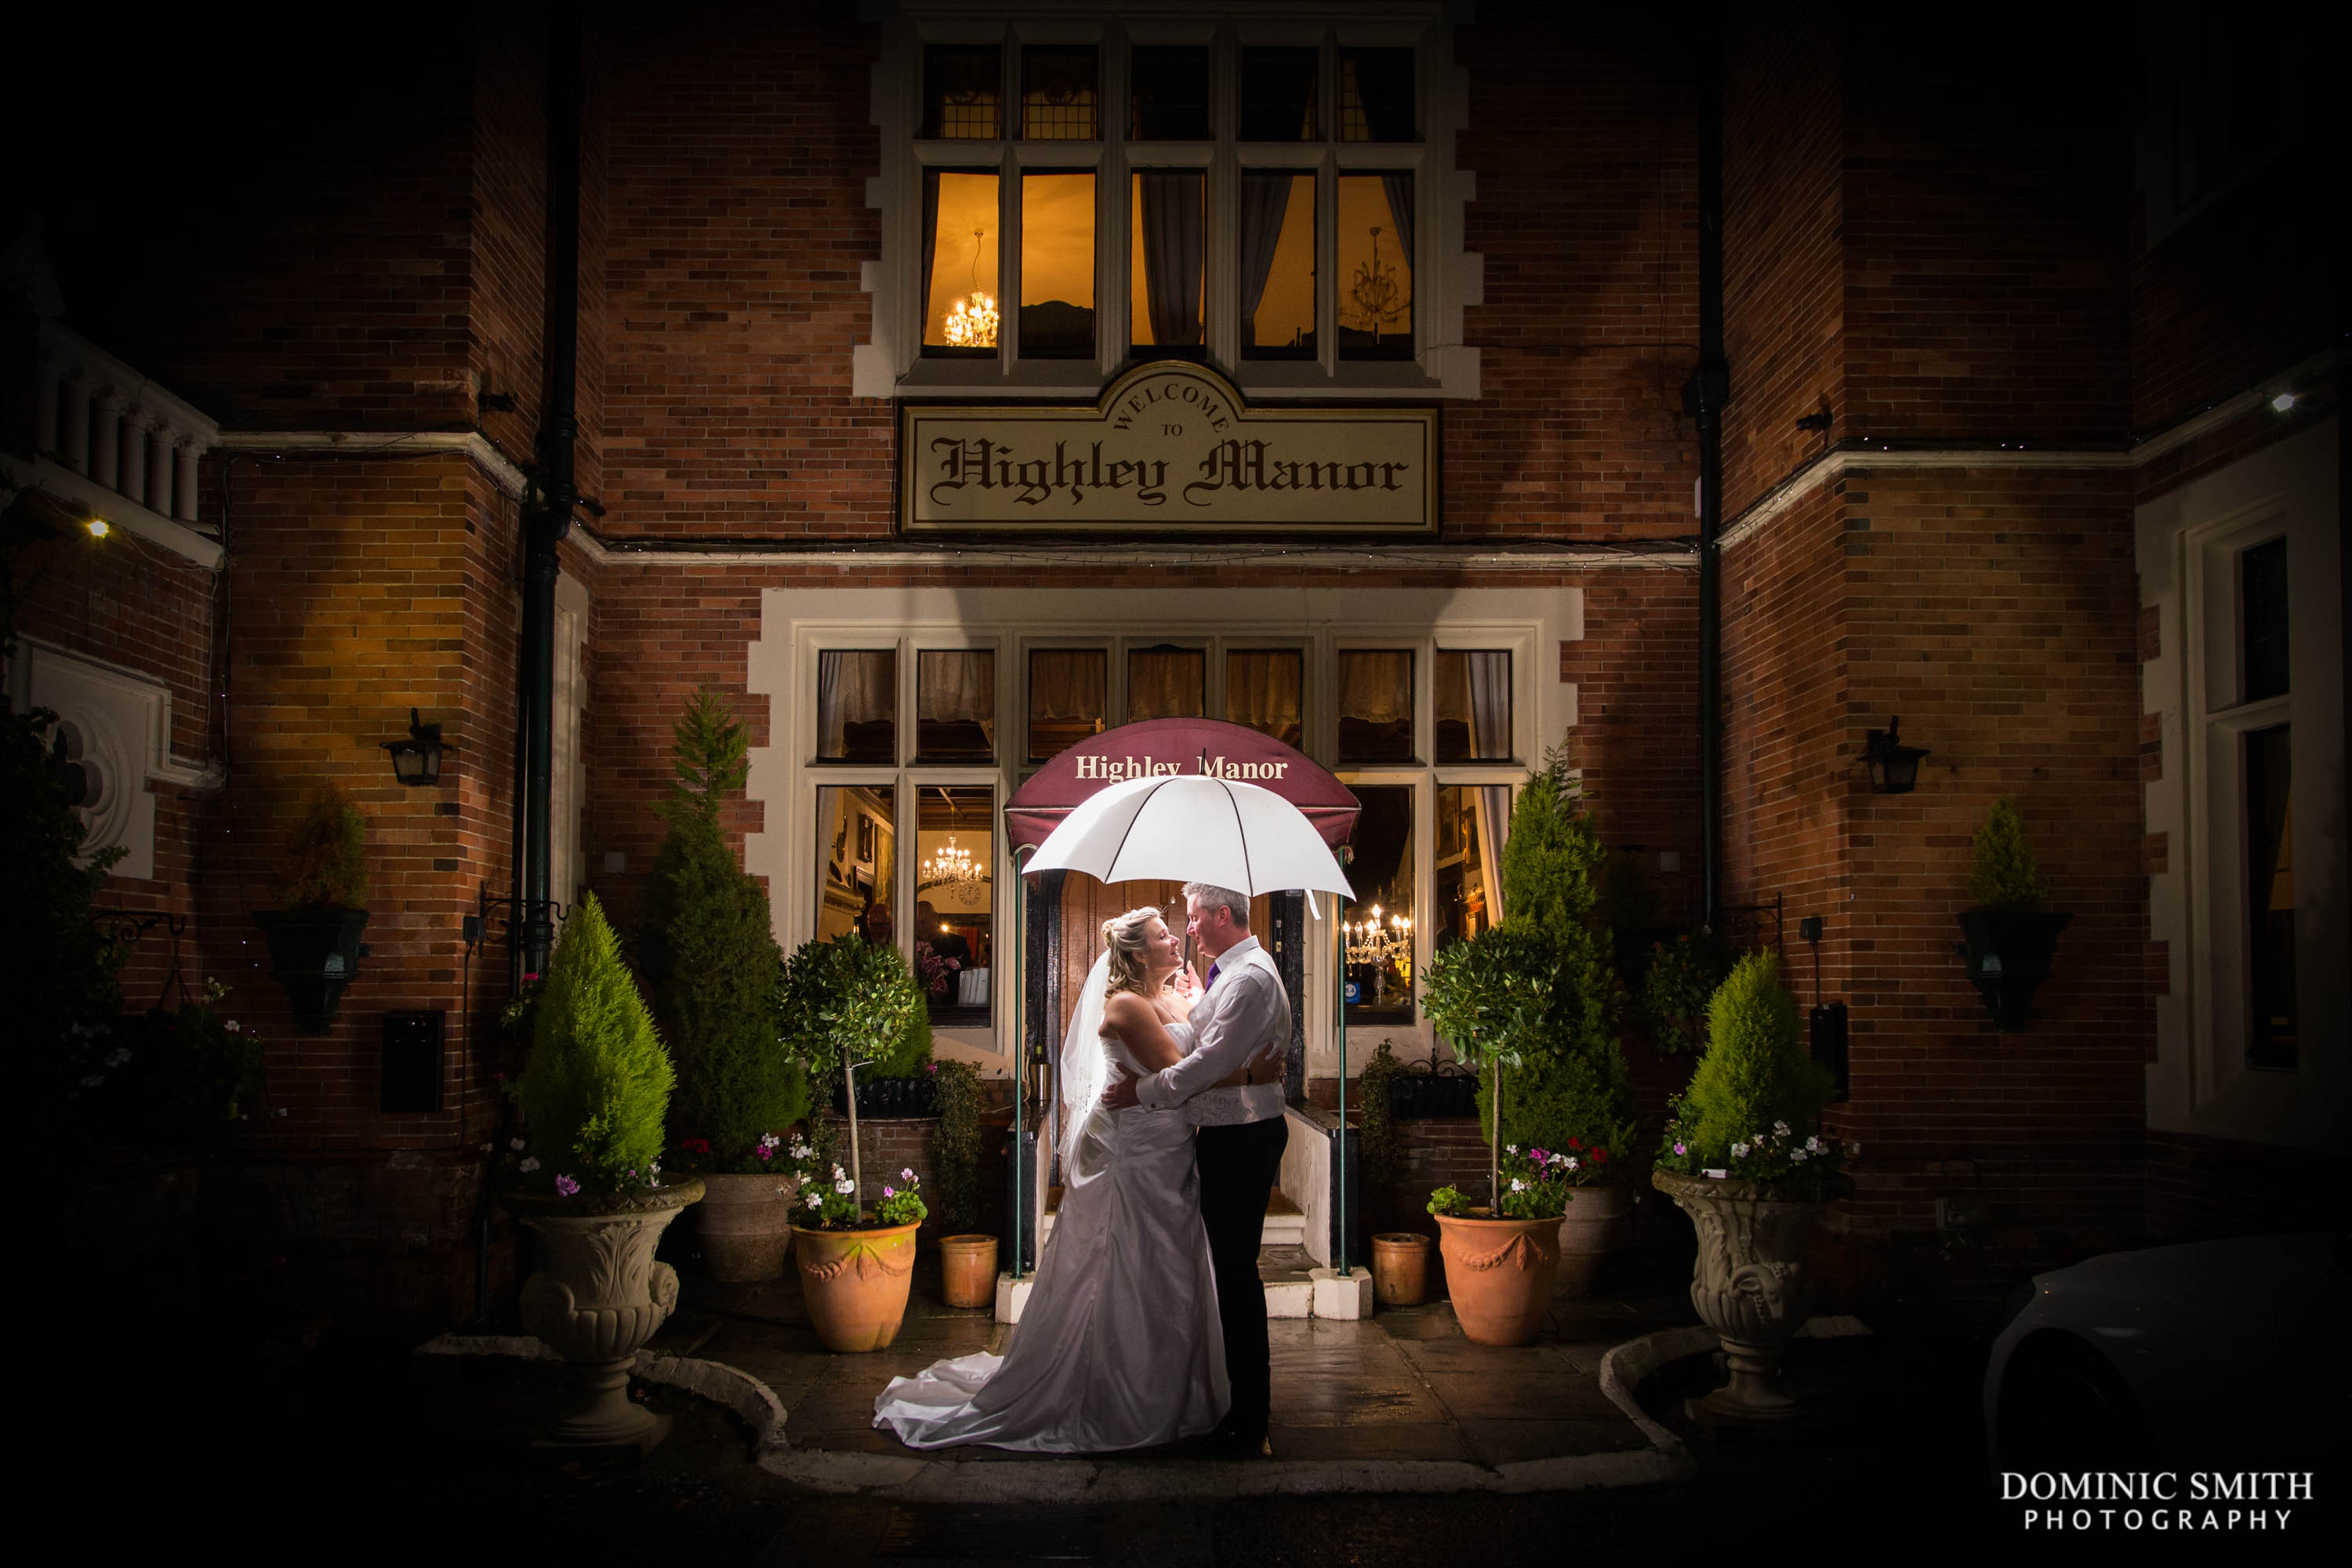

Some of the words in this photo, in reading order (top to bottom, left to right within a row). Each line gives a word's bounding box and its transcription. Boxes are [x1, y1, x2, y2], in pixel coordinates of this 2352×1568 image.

[1113, 383, 1229, 434] WELCOME
[1161, 424, 1182, 437] TO
[931, 437, 1171, 506] Highley
[1182, 438, 1409, 506] Manor
[1196, 755, 1288, 780] Manor
